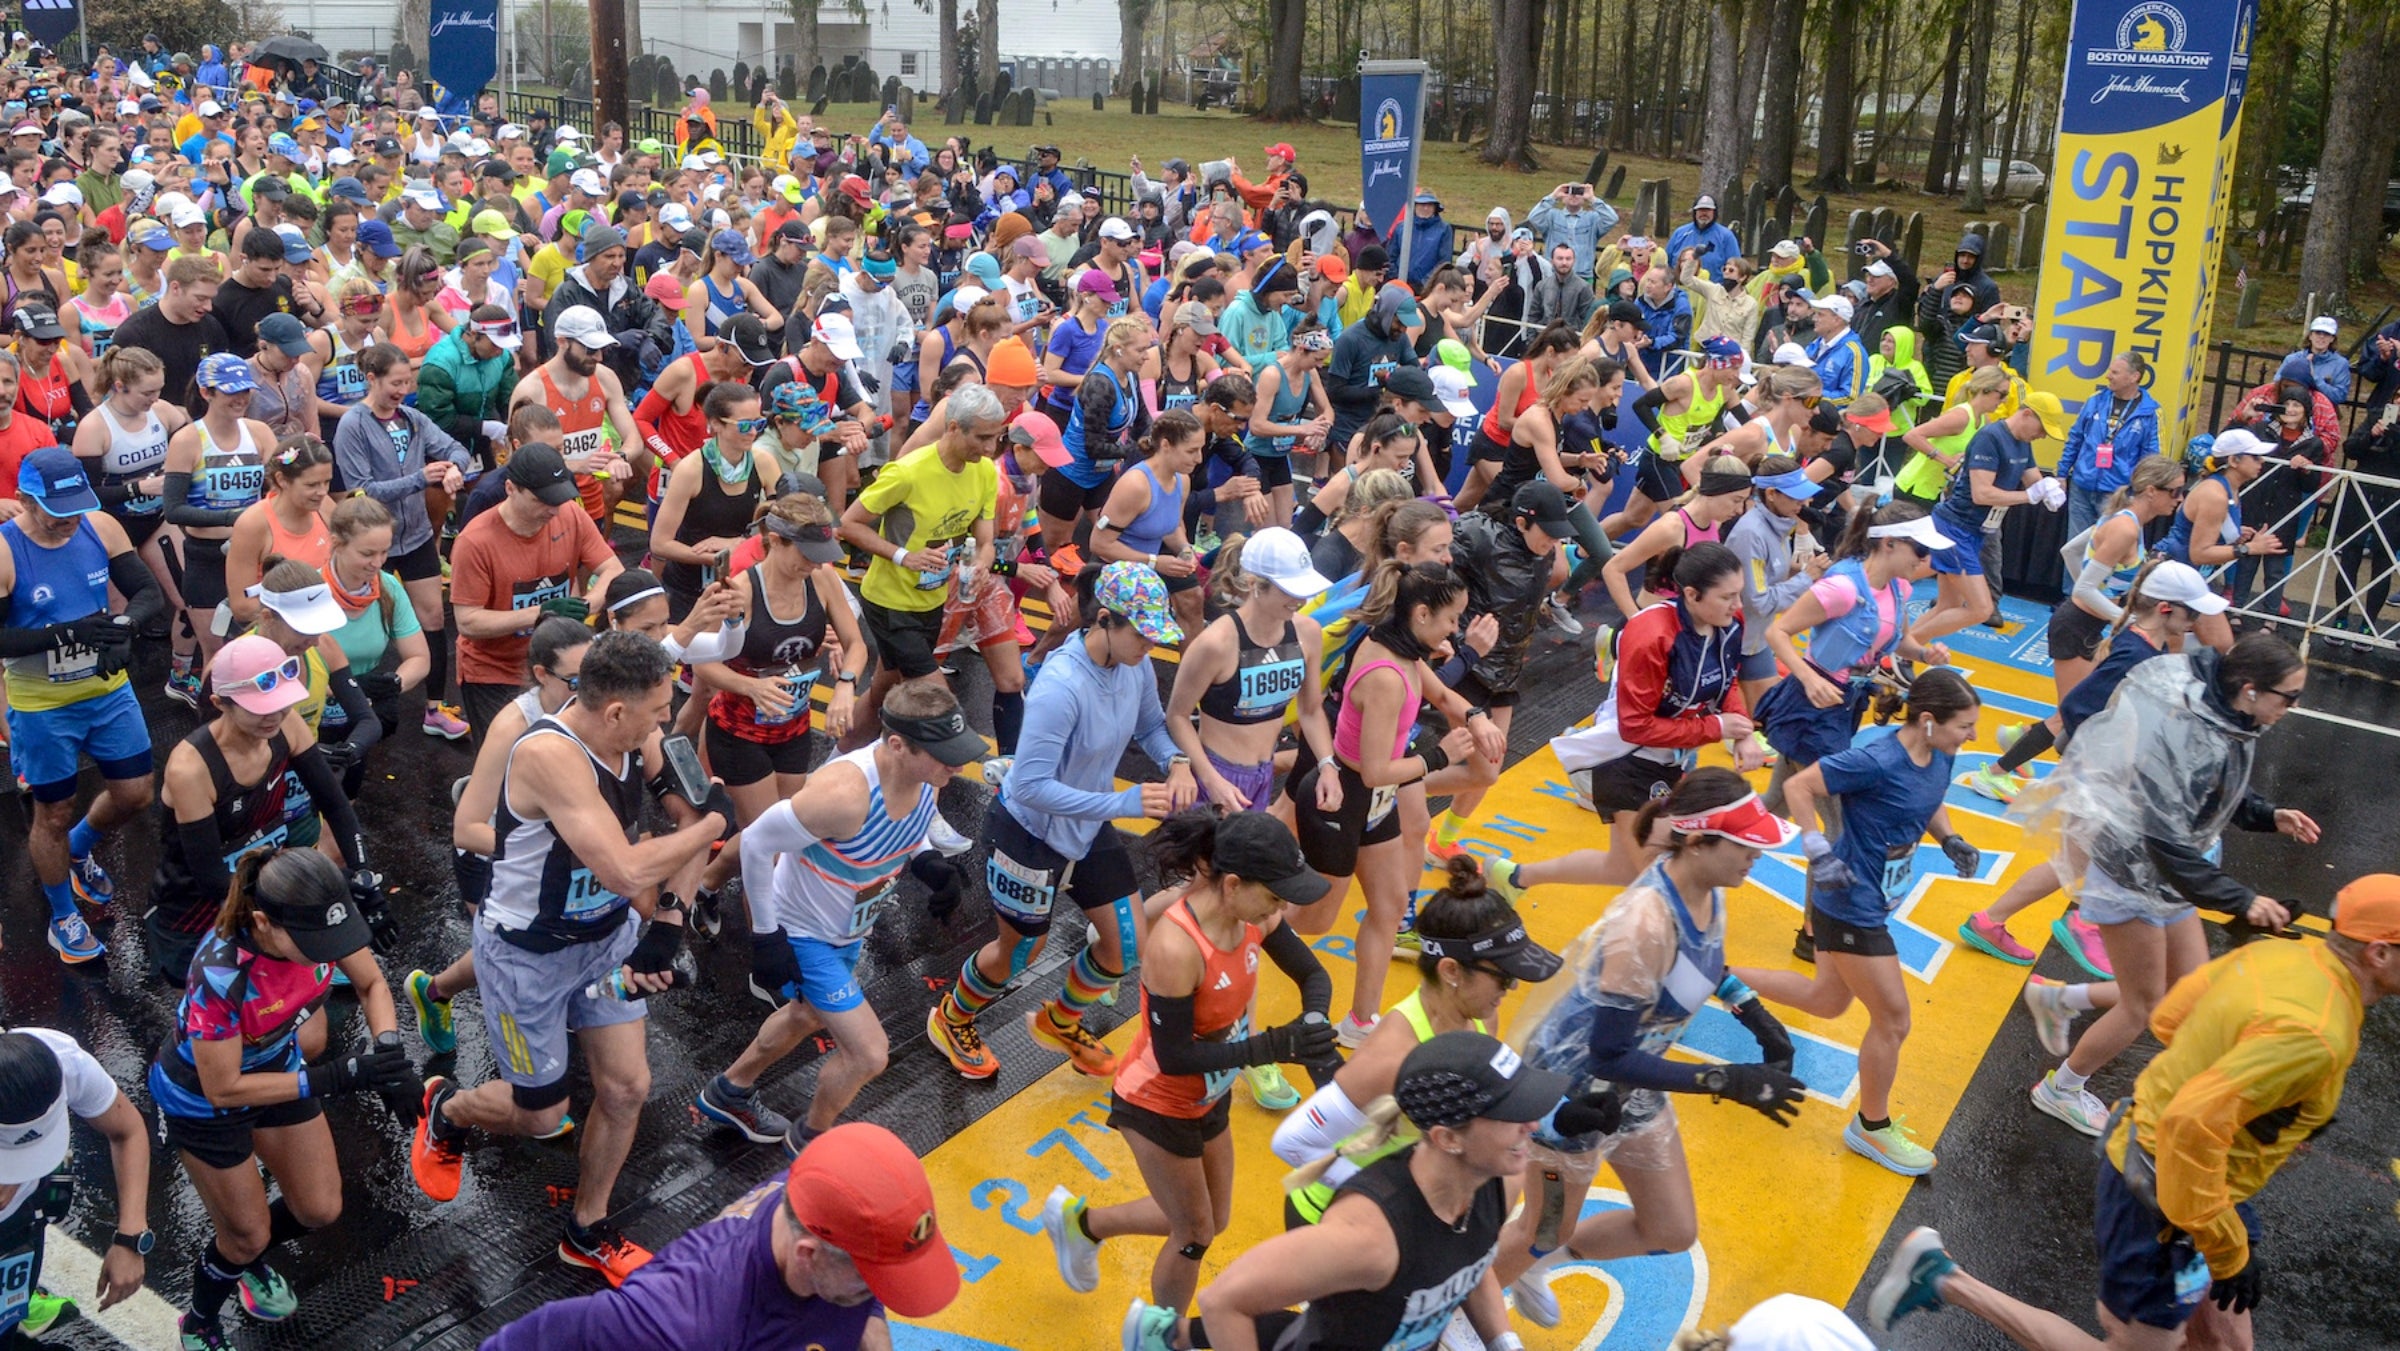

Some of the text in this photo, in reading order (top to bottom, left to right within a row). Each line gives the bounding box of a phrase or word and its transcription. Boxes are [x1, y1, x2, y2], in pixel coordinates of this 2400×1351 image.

[2087, 51, 2212, 66] BOSTON MARATHON
[2090, 74, 2191, 104] John Hancock
[2046, 148, 2140, 413] STAR
[2130, 175, 2184, 389] HOPKINTO
[119, 441, 168, 466] COLBY
[563, 433, 597, 456] 8462
[209, 470, 263, 491] 16453
[1245, 667, 1306, 697] 16965
[993, 848, 1045, 885] HAILEY
[986, 863, 1049, 906] 16881
